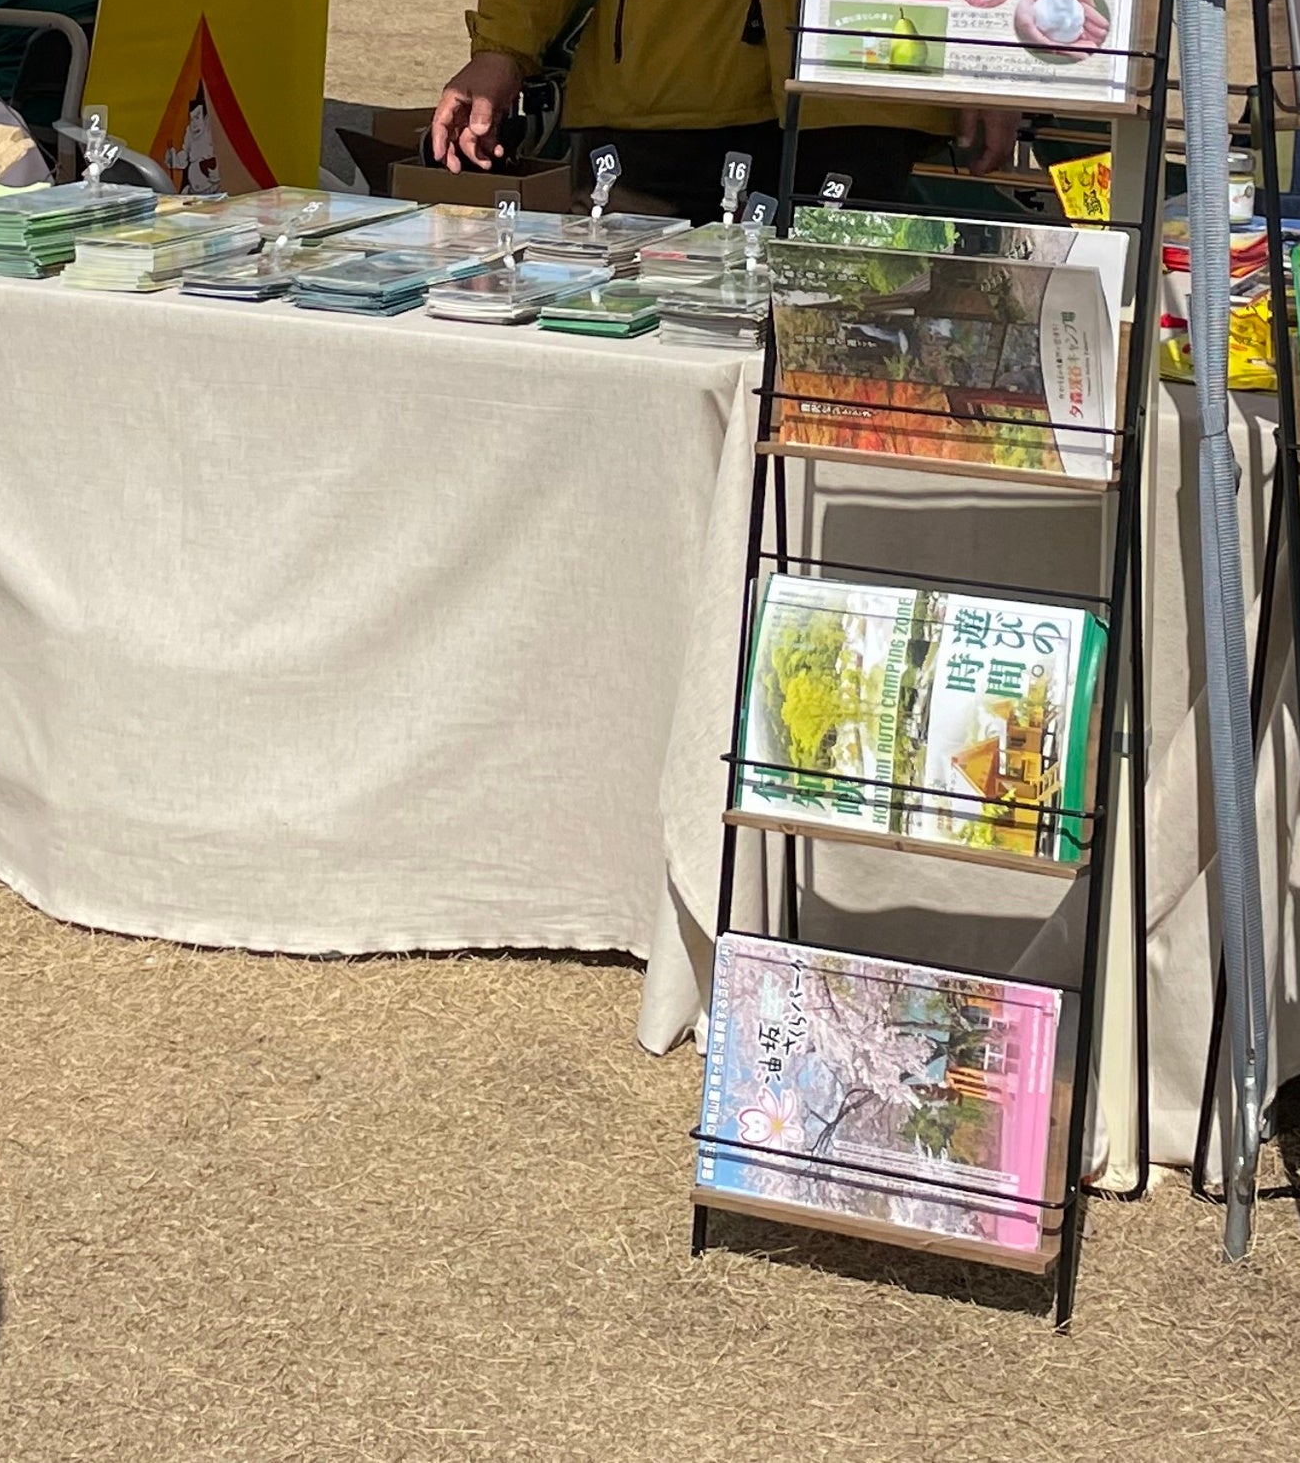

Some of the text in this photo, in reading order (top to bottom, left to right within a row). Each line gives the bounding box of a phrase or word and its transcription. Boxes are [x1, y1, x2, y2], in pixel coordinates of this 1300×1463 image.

[89, 115, 100, 132] 2
[101, 143, 116, 159] 14
[595, 153, 616, 173] 20
[728, 162, 746, 180] 16
[824, 180, 844, 198] 29
[498, 201, 516, 219] 24
[752, 203, 766, 222] 5
[952, 607, 1062, 654] 遊びの
[945, 654, 1046, 698] 時間。
[782, 957, 808, 1055] さくらパーク
[757, 1021, 782, 1085] 油坂
